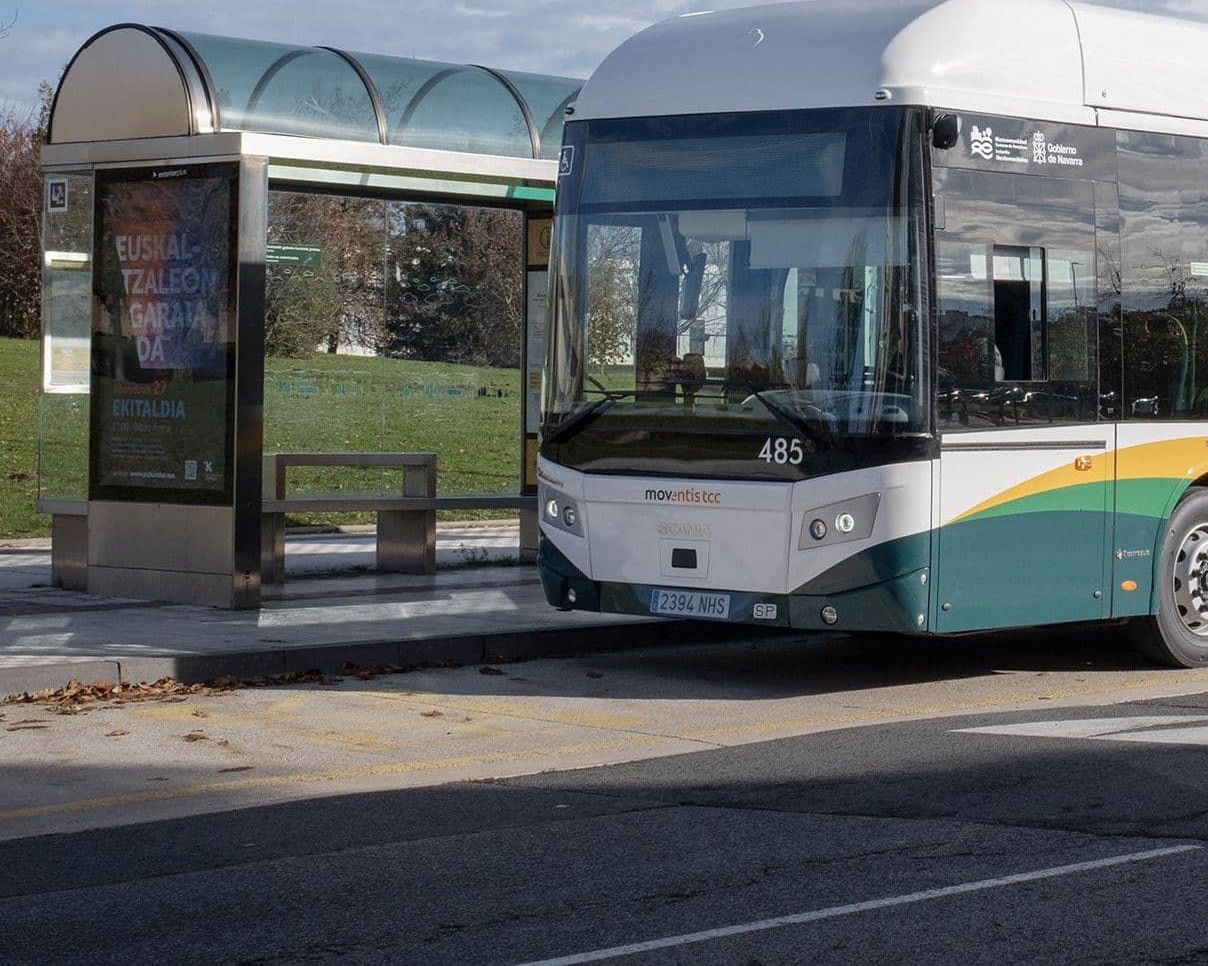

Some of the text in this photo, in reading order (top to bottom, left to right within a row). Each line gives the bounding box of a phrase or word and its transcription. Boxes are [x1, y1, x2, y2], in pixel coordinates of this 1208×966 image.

[1047, 142, 1077, 155] Gobierno
[1047, 154, 1083, 166] de Navarra
[136, 336, 164, 362] DA
[112, 398, 186, 419] EKITALDIA
[758, 437, 803, 465] 485
[645, 487, 721, 504] moventis tcc
[660, 593, 726, 615] 2394 NHS
[754, 604, 775, 618] SP
